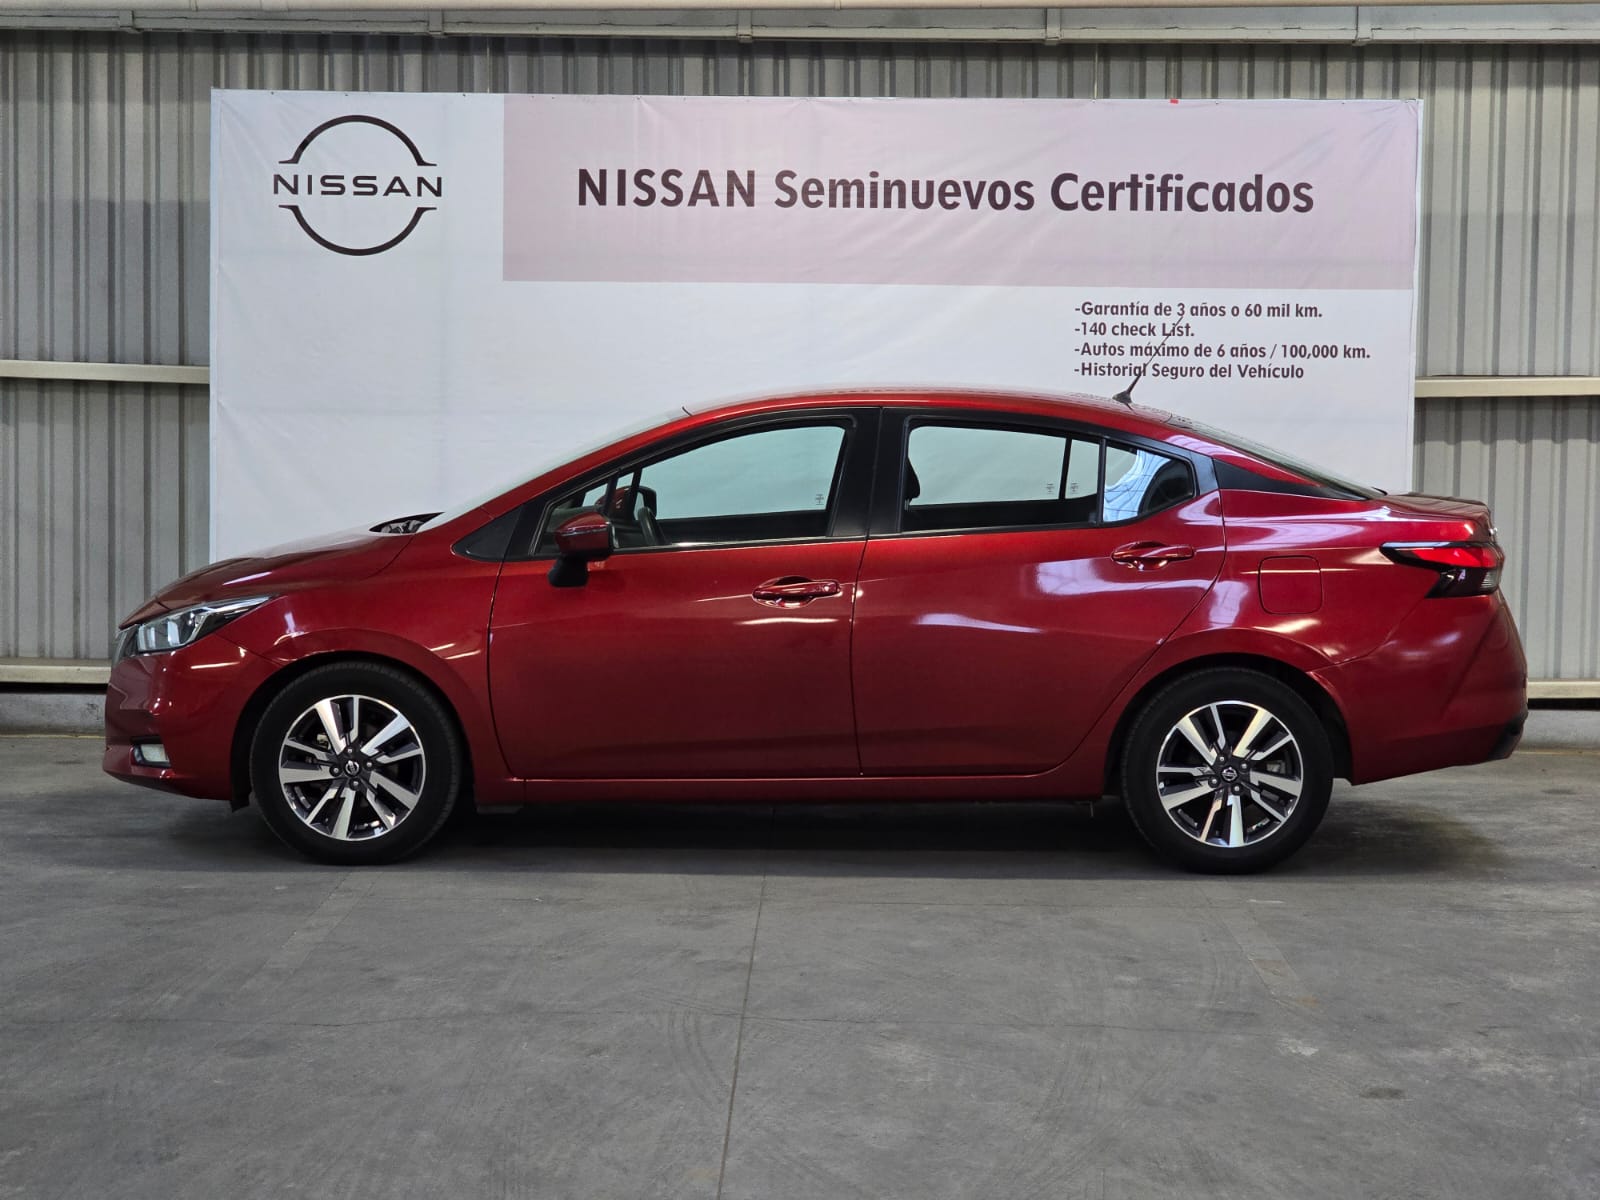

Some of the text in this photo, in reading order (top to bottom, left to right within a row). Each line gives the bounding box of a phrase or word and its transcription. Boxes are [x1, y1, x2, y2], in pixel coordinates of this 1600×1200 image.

[273, 174, 443, 198] NISSAN
[578, 168, 1314, 214] NISSAN Seminuevos Certificados
[1074, 301, 1323, 318] -Garantía de 3 años o 60 mil km.
[1074, 322, 1195, 337] -140 check List.
[1074, 341, 1371, 360] -Autos máximo de 6 años / 100,000 km.
[1074, 362, 1304, 380] -Historial Seguro del Vehículo
